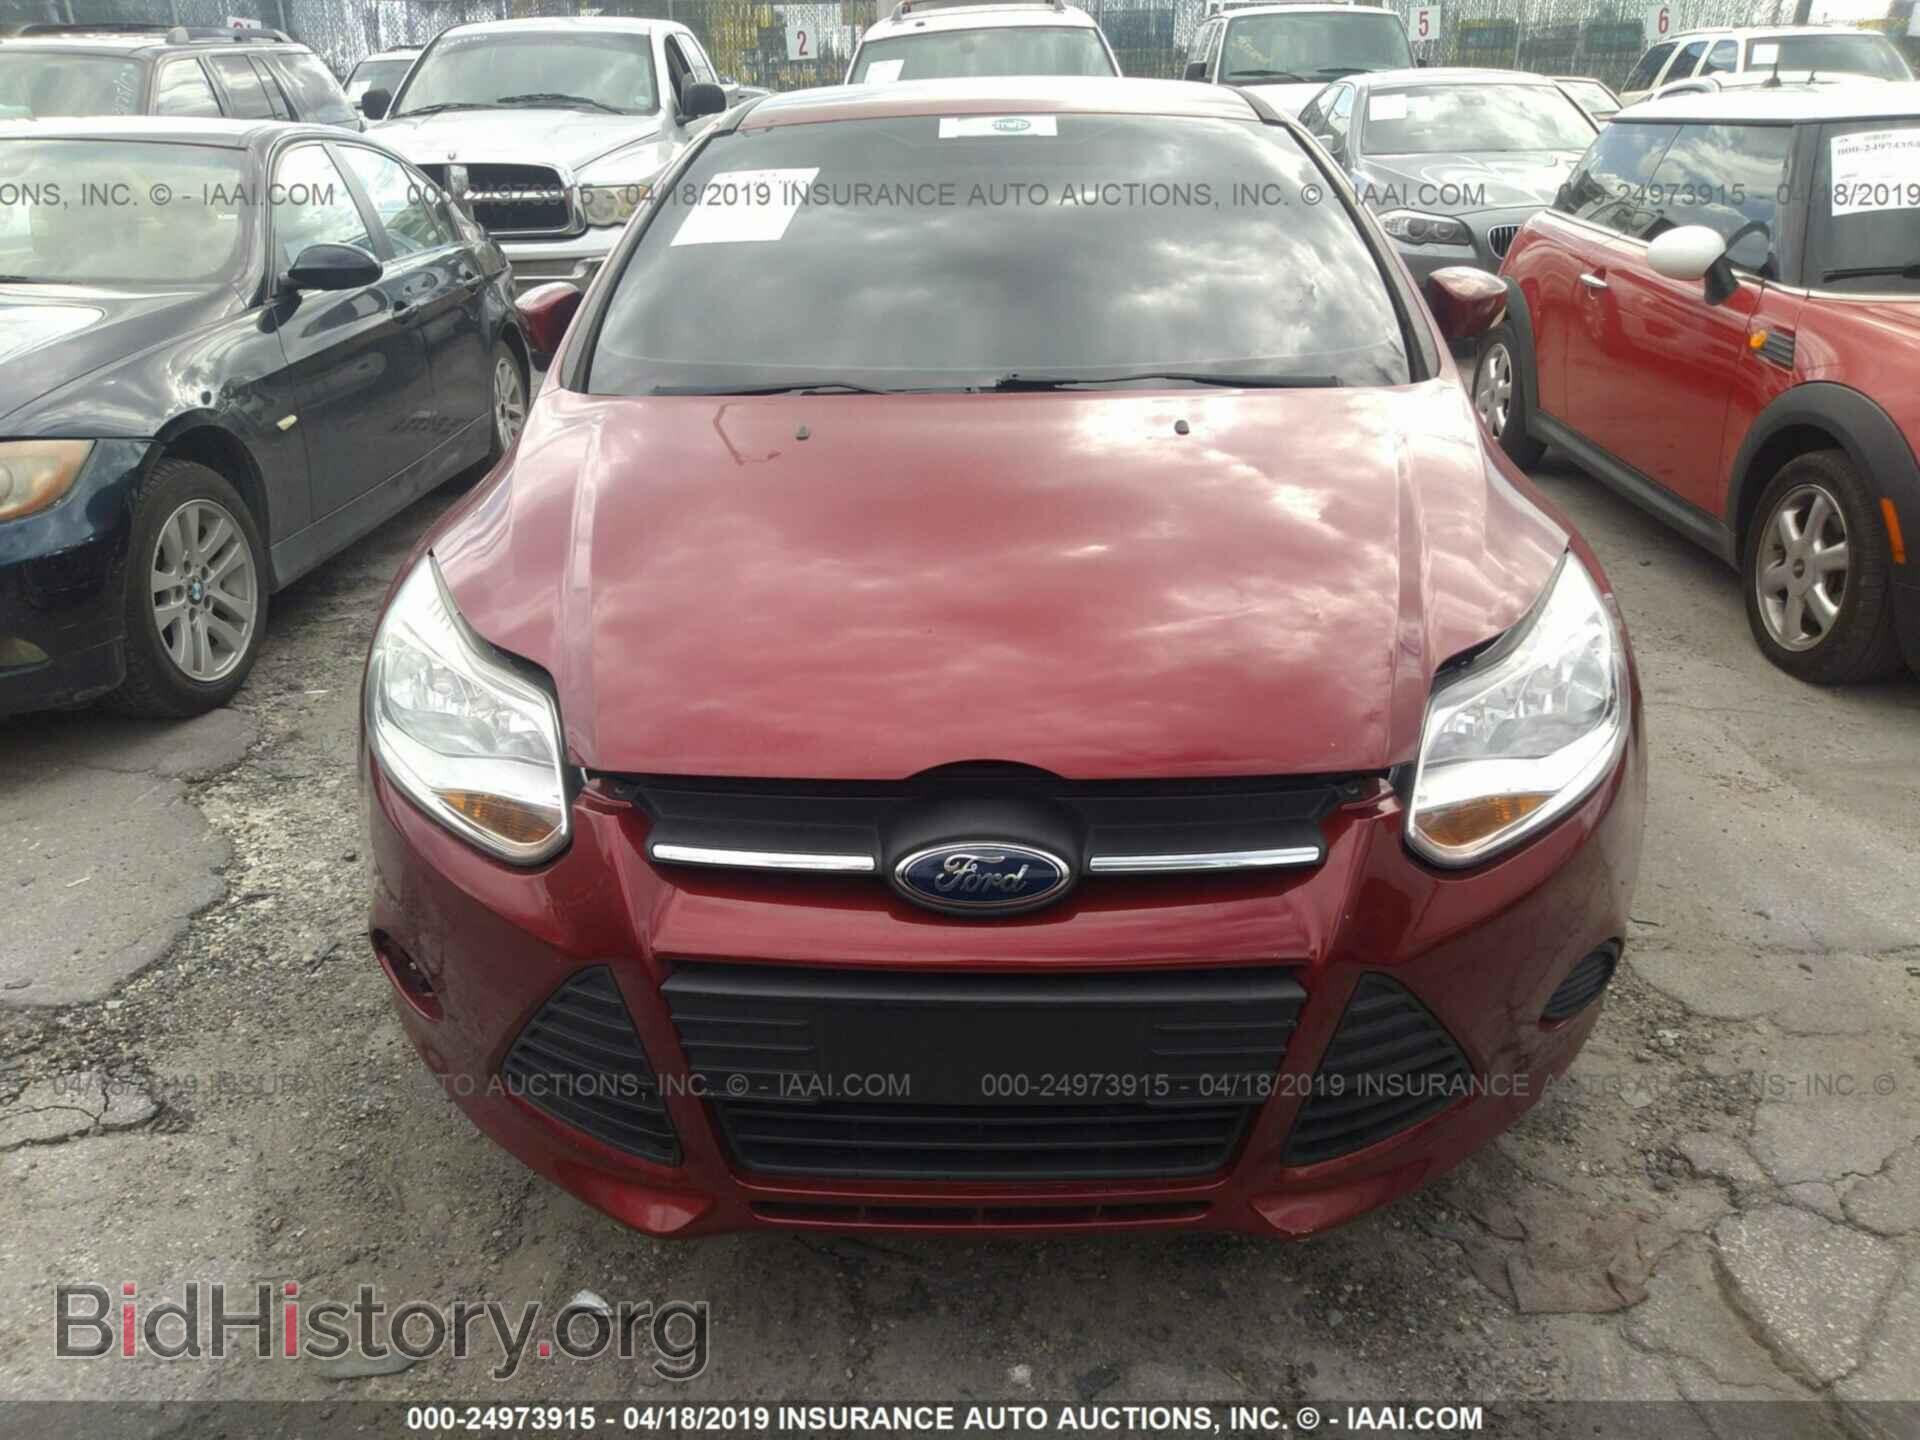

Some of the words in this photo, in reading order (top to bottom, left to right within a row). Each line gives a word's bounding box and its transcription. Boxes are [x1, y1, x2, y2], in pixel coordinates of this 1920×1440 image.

[1419, 11, 1429, 37] 5
[1659, 8, 1669, 34] 6
[797, 31, 808, 56] 2
[934, 854, 1029, 893] Ford
